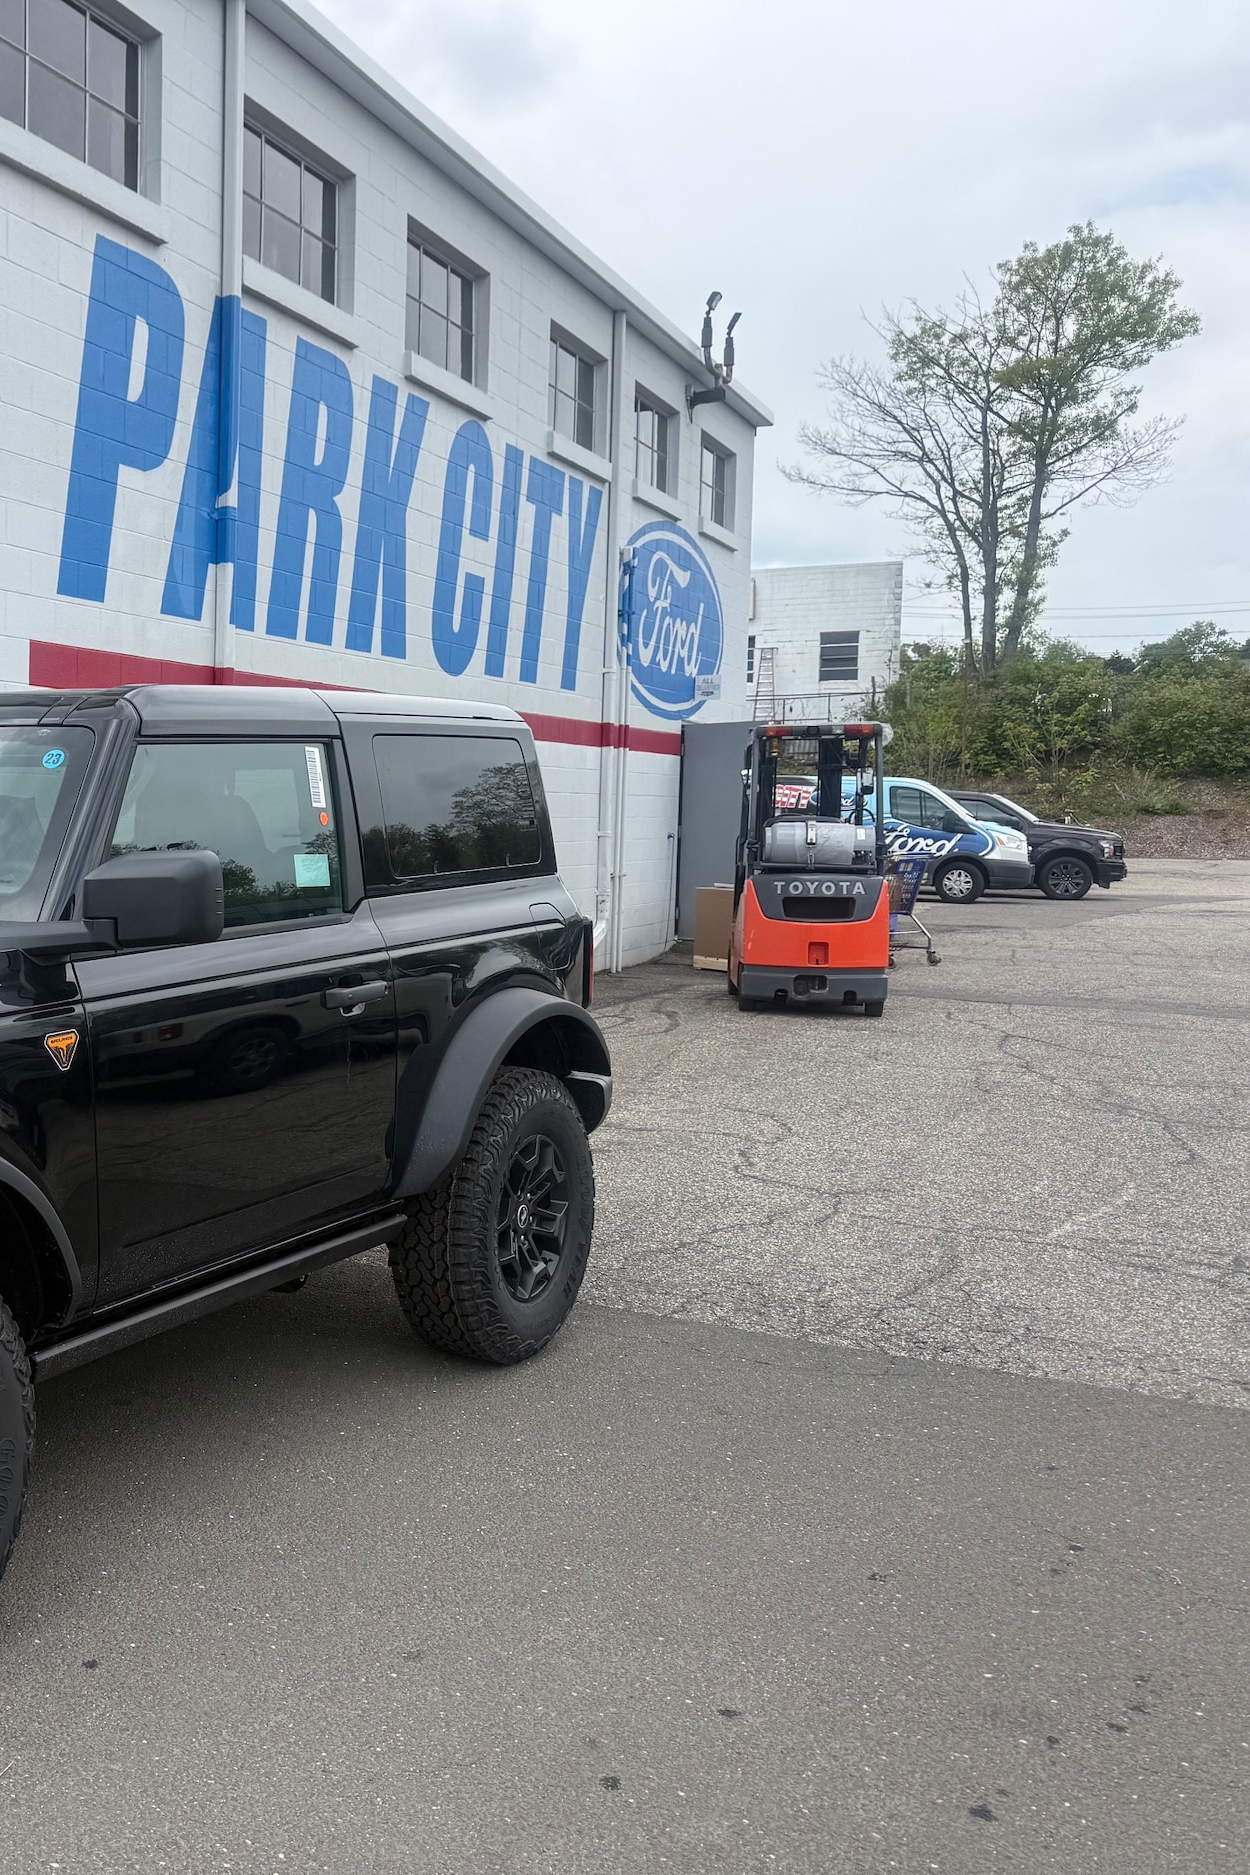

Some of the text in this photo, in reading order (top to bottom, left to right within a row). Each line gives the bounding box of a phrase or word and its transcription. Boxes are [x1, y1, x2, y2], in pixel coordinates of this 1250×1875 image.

[56, 233, 603, 691] PARK CITY
[638, 551, 705, 678] Ford
[44, 753, 62, 765] 23
[773, 881, 866, 895] TOYOTA
